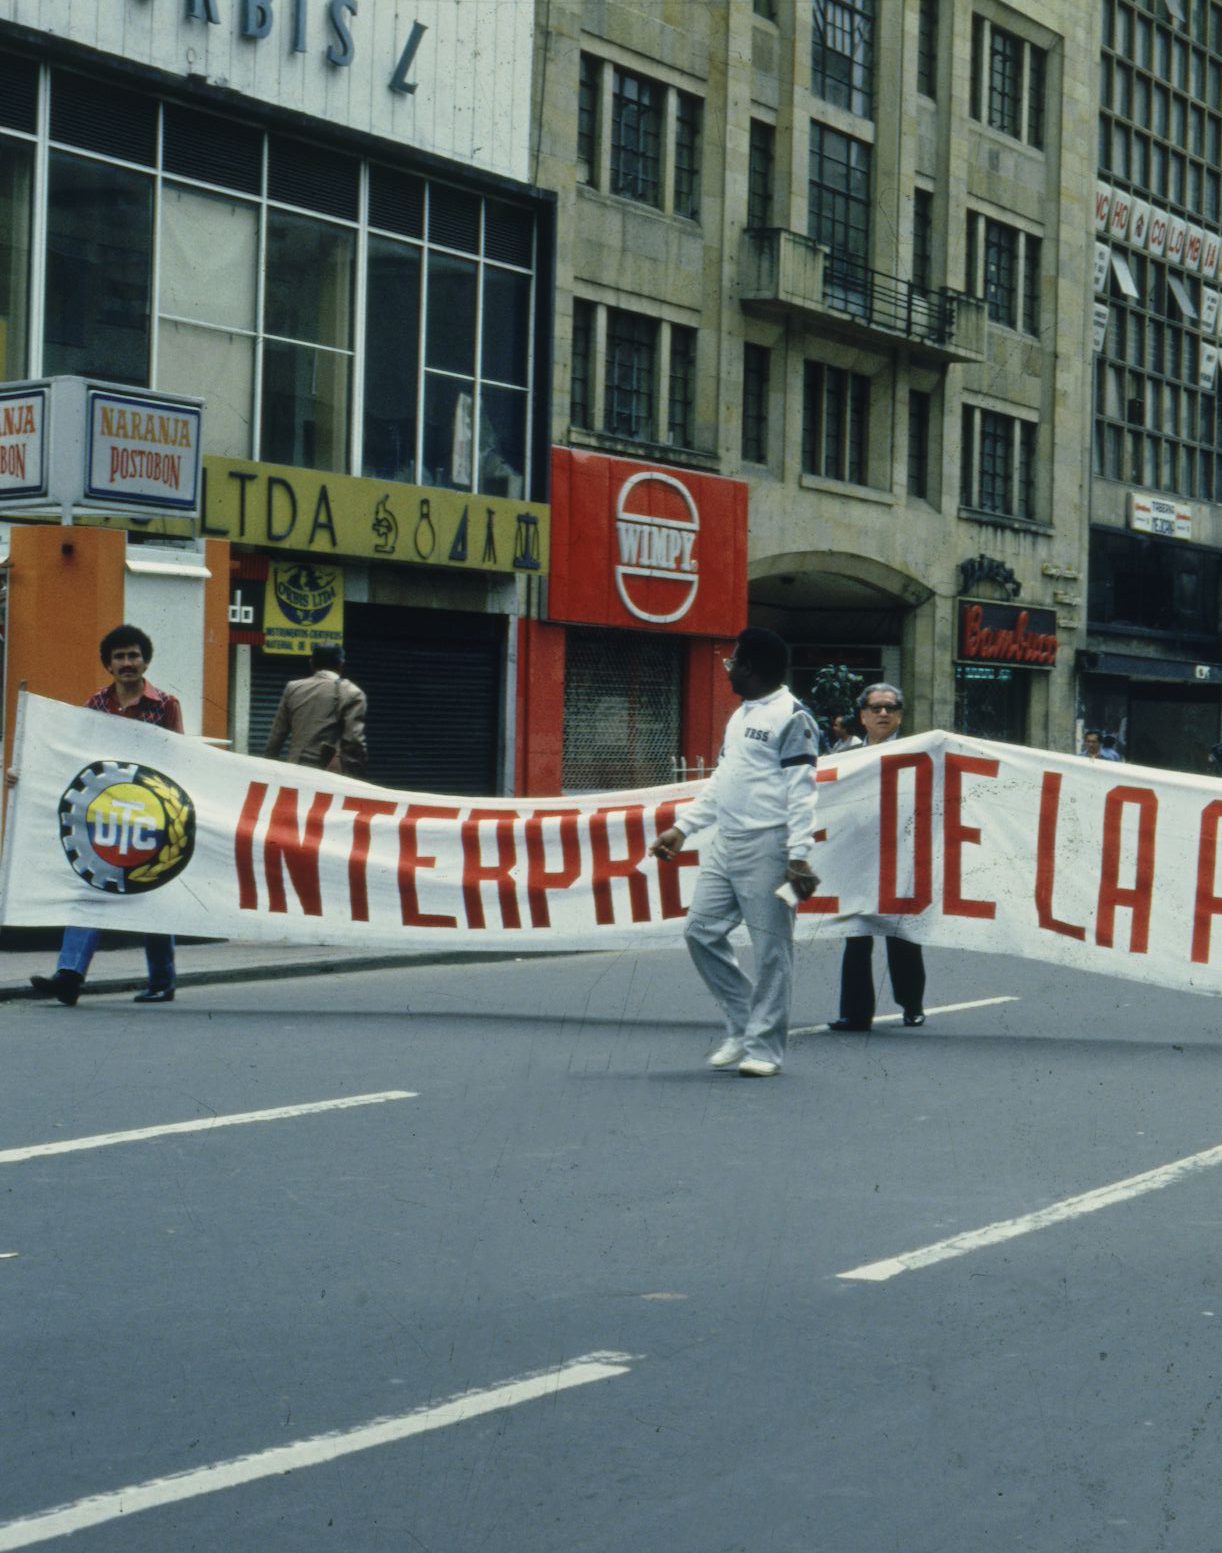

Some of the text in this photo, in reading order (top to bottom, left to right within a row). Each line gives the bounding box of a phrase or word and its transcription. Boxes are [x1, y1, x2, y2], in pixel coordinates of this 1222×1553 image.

[137, 0, 358, 67] BIS
[0, 404, 37, 437] NJA
[100, 406, 192, 449] NARANJA
[109, 446, 182, 491] POSTOBON
[201, 466, 338, 549] LTDA
[616, 521, 697, 572] WIMPY
[94, 798, 158, 855] UTC
[234, 767, 840, 930] INTERPRE
[878, 752, 1000, 920] DE
[1035, 771, 1159, 955] LA
